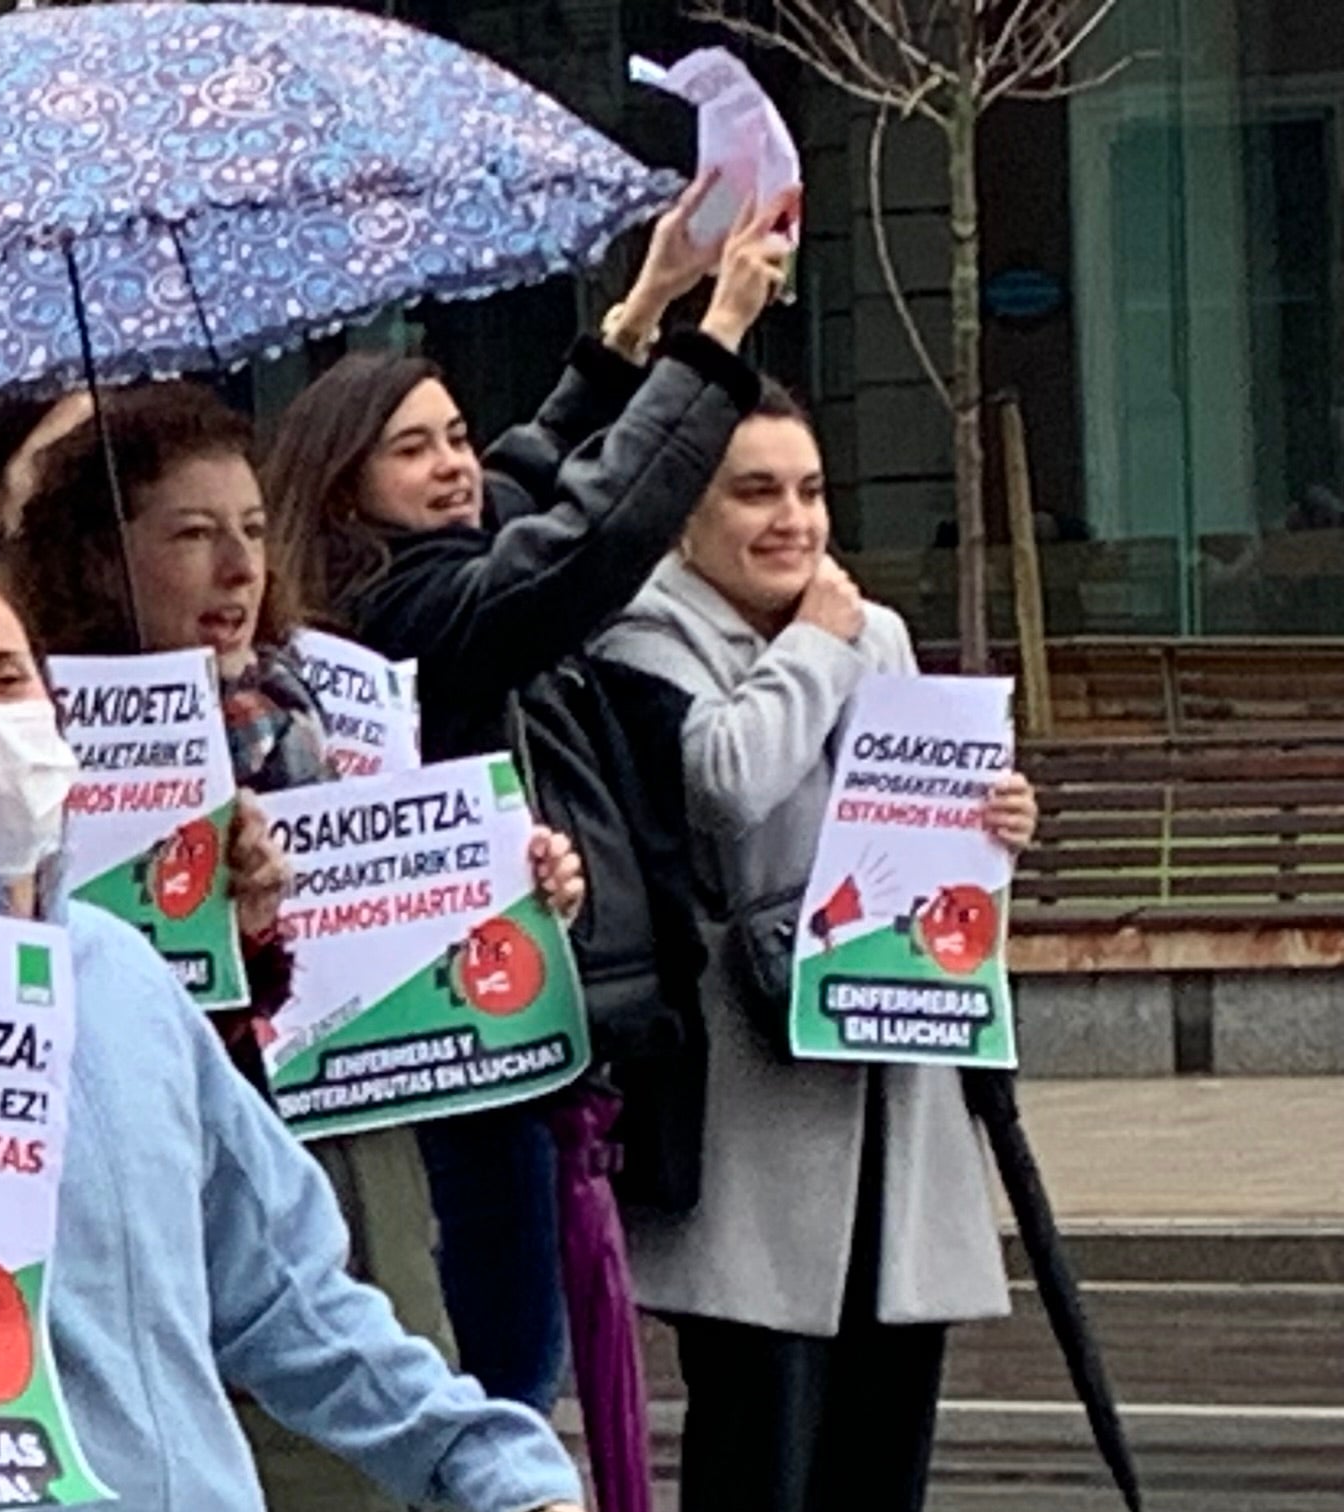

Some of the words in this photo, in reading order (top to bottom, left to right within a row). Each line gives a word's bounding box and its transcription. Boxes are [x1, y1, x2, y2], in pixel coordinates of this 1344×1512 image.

[394, 880, 492, 922] HARTAS
[844, 1016, 879, 1042] EN
[0, 1088, 48, 1124] EZ!
